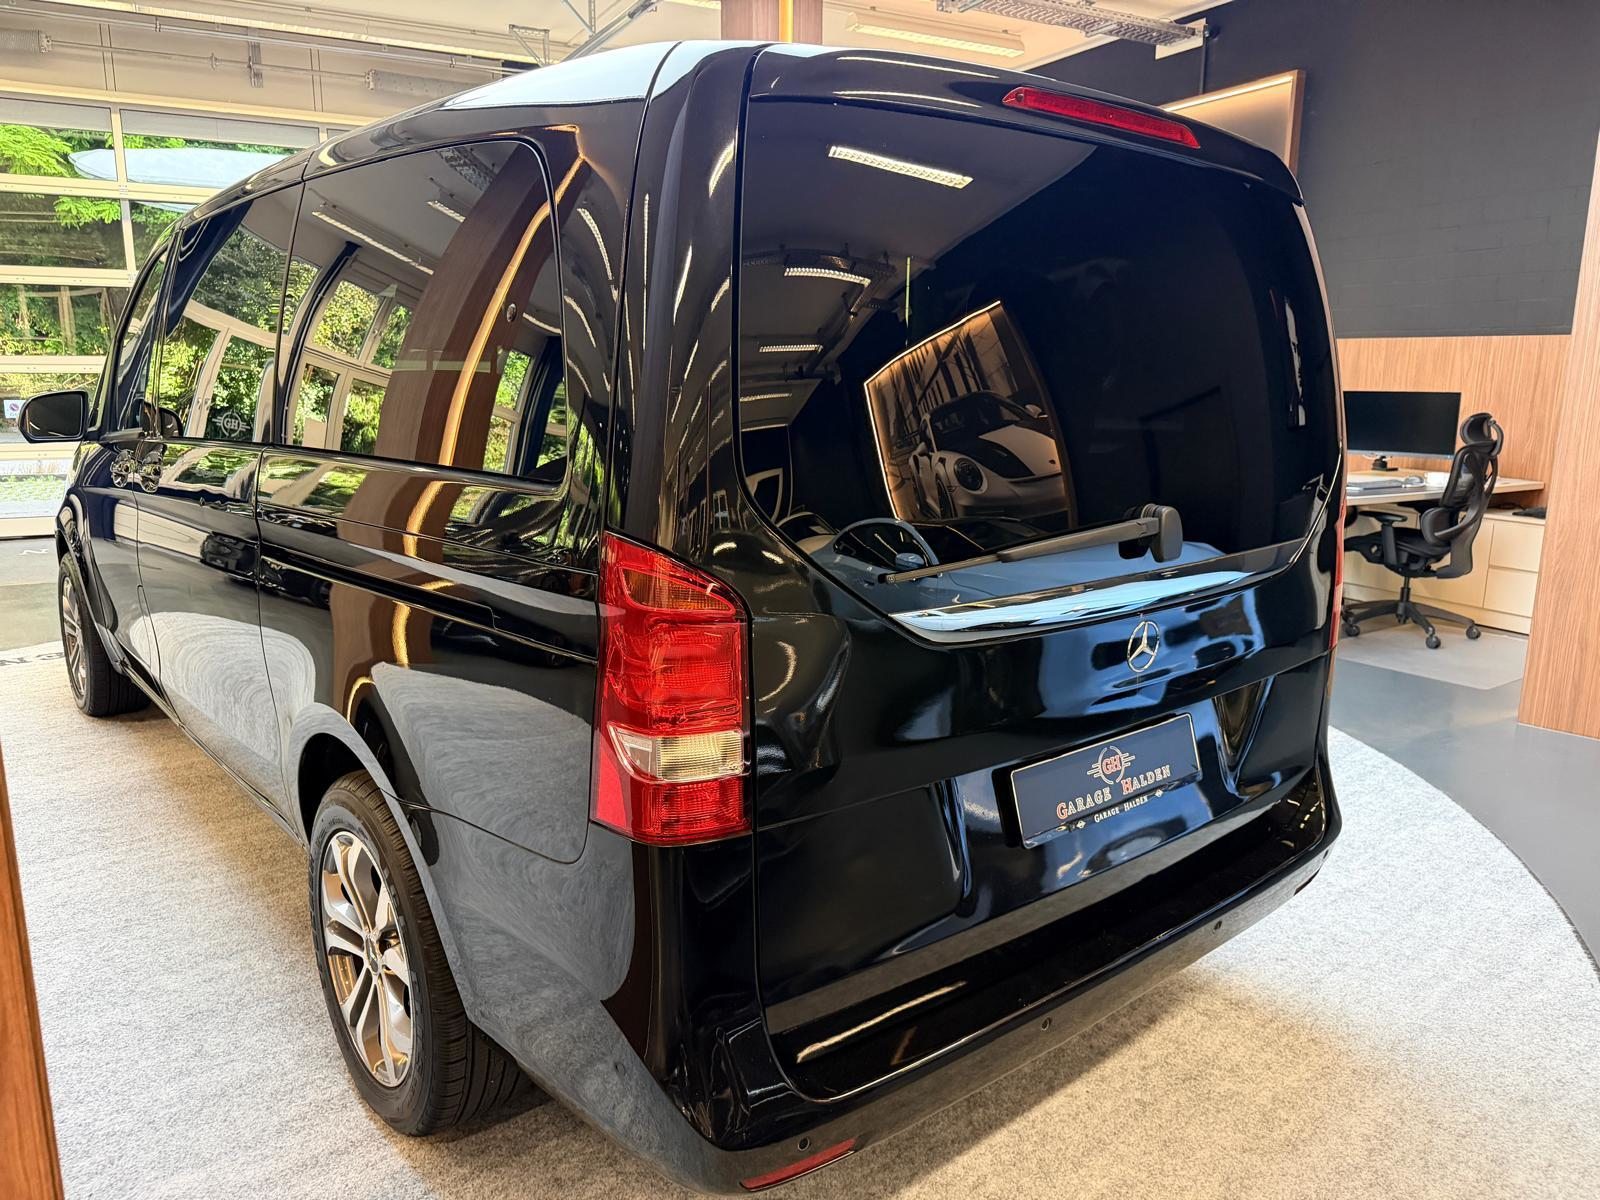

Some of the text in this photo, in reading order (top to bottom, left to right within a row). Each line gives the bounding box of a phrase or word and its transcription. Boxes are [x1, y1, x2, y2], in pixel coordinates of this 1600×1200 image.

[1102, 754, 1122, 775] GH
[1056, 764, 1171, 820] GARAGE HALDEN
